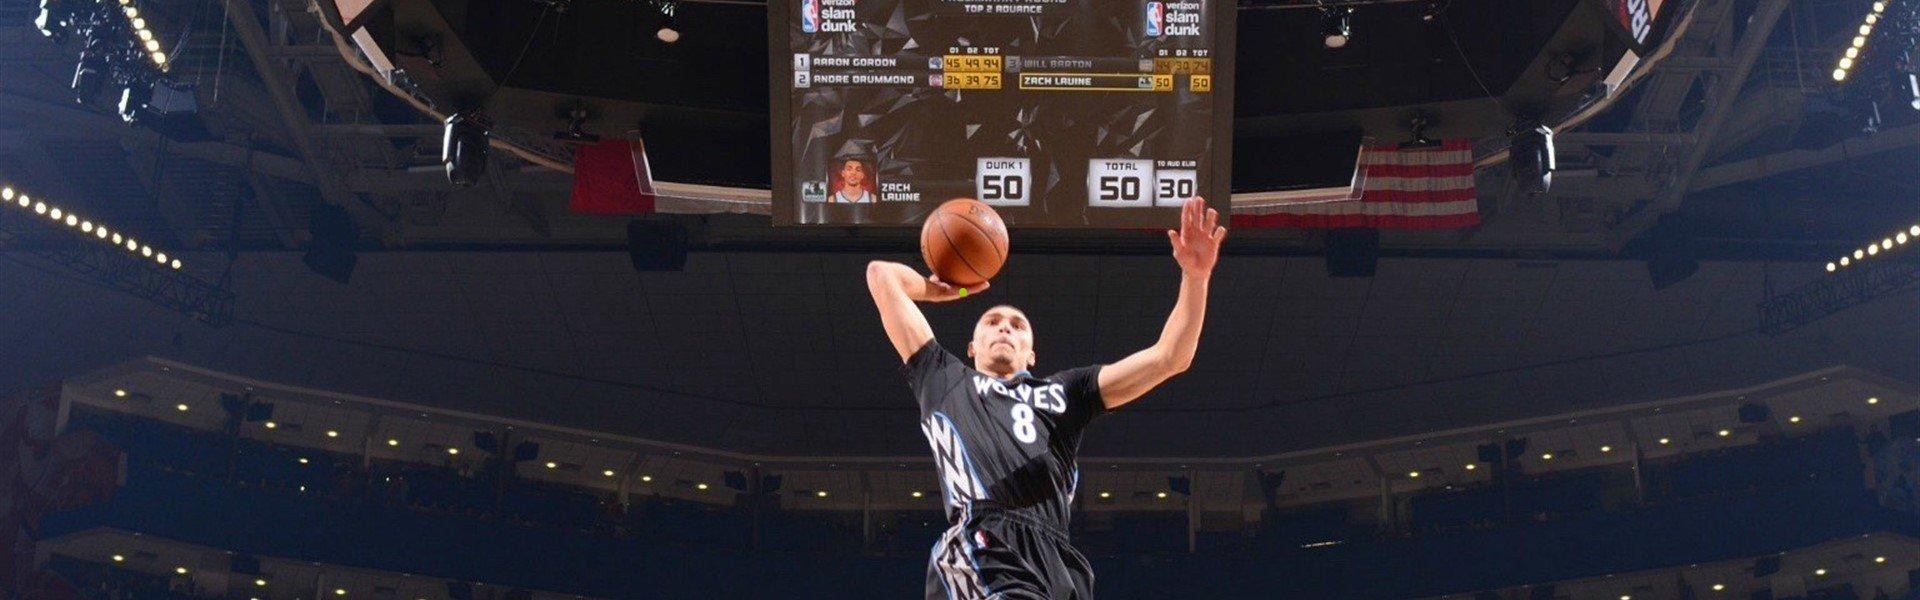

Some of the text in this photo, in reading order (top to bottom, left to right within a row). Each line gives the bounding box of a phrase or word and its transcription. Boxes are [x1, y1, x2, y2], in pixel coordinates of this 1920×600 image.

[1166, 1, 1200, 10] verizon
[821, 6, 856, 19] slam
[1165, 10, 1199, 23] slam
[821, 19, 857, 32] dunk
[1164, 23, 1200, 36] dunk
[813, 58, 850, 67] AARON
[853, 58, 897, 67] GORDON
[946, 59, 960, 68] 45
[965, 59, 980, 68] 49
[983, 59, 999, 68] 94
[1050, 60, 1092, 68] BARTON
[798, 75, 806, 84] 2
[813, 75, 850, 84] ANDRE
[852, 75, 915, 84] DRUMMOND
[966, 75, 980, 85] 39
[983, 75, 999, 85] 75
[1024, 76, 1208, 88] ZACH LAVINE 50 50
[986, 161, 1016, 170] DUNK
[1105, 162, 1138, 171] TOTAL
[881, 183, 911, 192] ZACH
[983, 175, 1023, 200] 50
[1100, 176, 1140, 201] 50
[1159, 178, 1193, 199] 30
[881, 193, 920, 202] LAVINE
[973, 375, 1066, 414] WOLVES
[1011, 403, 1037, 443] 8
